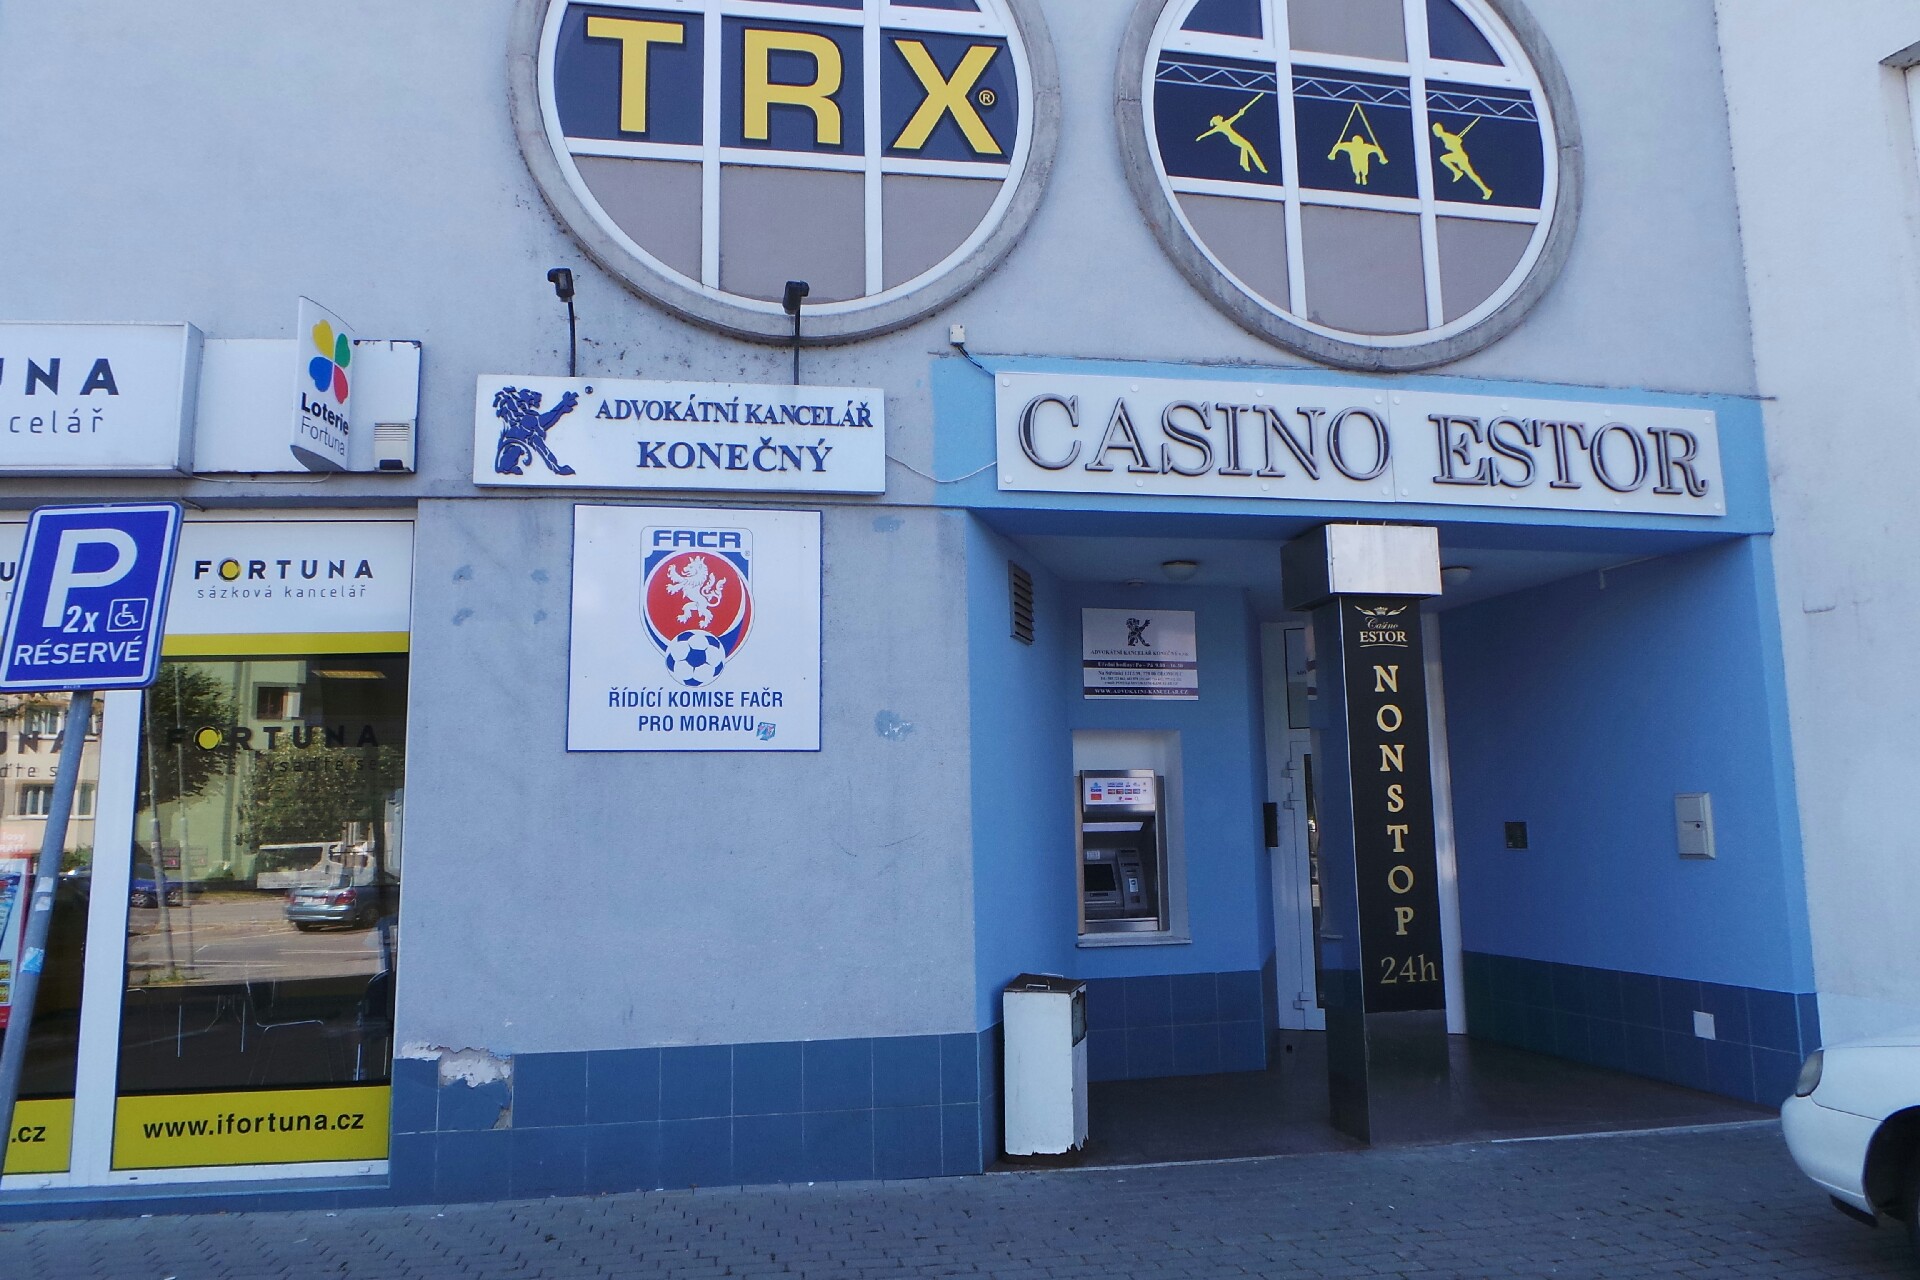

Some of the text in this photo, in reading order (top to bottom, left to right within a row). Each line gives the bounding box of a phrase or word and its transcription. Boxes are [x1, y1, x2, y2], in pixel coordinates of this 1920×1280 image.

[301, 392, 349, 435] Loterie
[595, 394, 873, 428] ADVOKÁTNÍ KANCELÁŘ
[301, 415, 345, 456] Fortuna
[1017, 393, 1710, 497] CASINO ESTOR
[636, 436, 833, 472] KONEČNÝ
[653, 530, 741, 548] FAČR
[42, 528, 138, 628] P
[194, 557, 373, 582] FORTUNA
[197, 584, 367, 599] sázková kancelář
[63, 605, 100, 633] 2x
[1365, 616, 1399, 629] Casino
[1359, 630, 1408, 642] ESTOR
[14, 635, 143, 666] RÉSERVÉ
[608, 686, 783, 708] ŘÍDÍCÍ KOMISE FAČR
[638, 715, 754, 731] PRO MORAVU
[166, 724, 379, 751] FORTUNA
[1373, 664, 1414, 937] NONSTOP
[1380, 953, 1438, 984] 24h
[144, 1112, 364, 1138] www.ifortuna.cz
